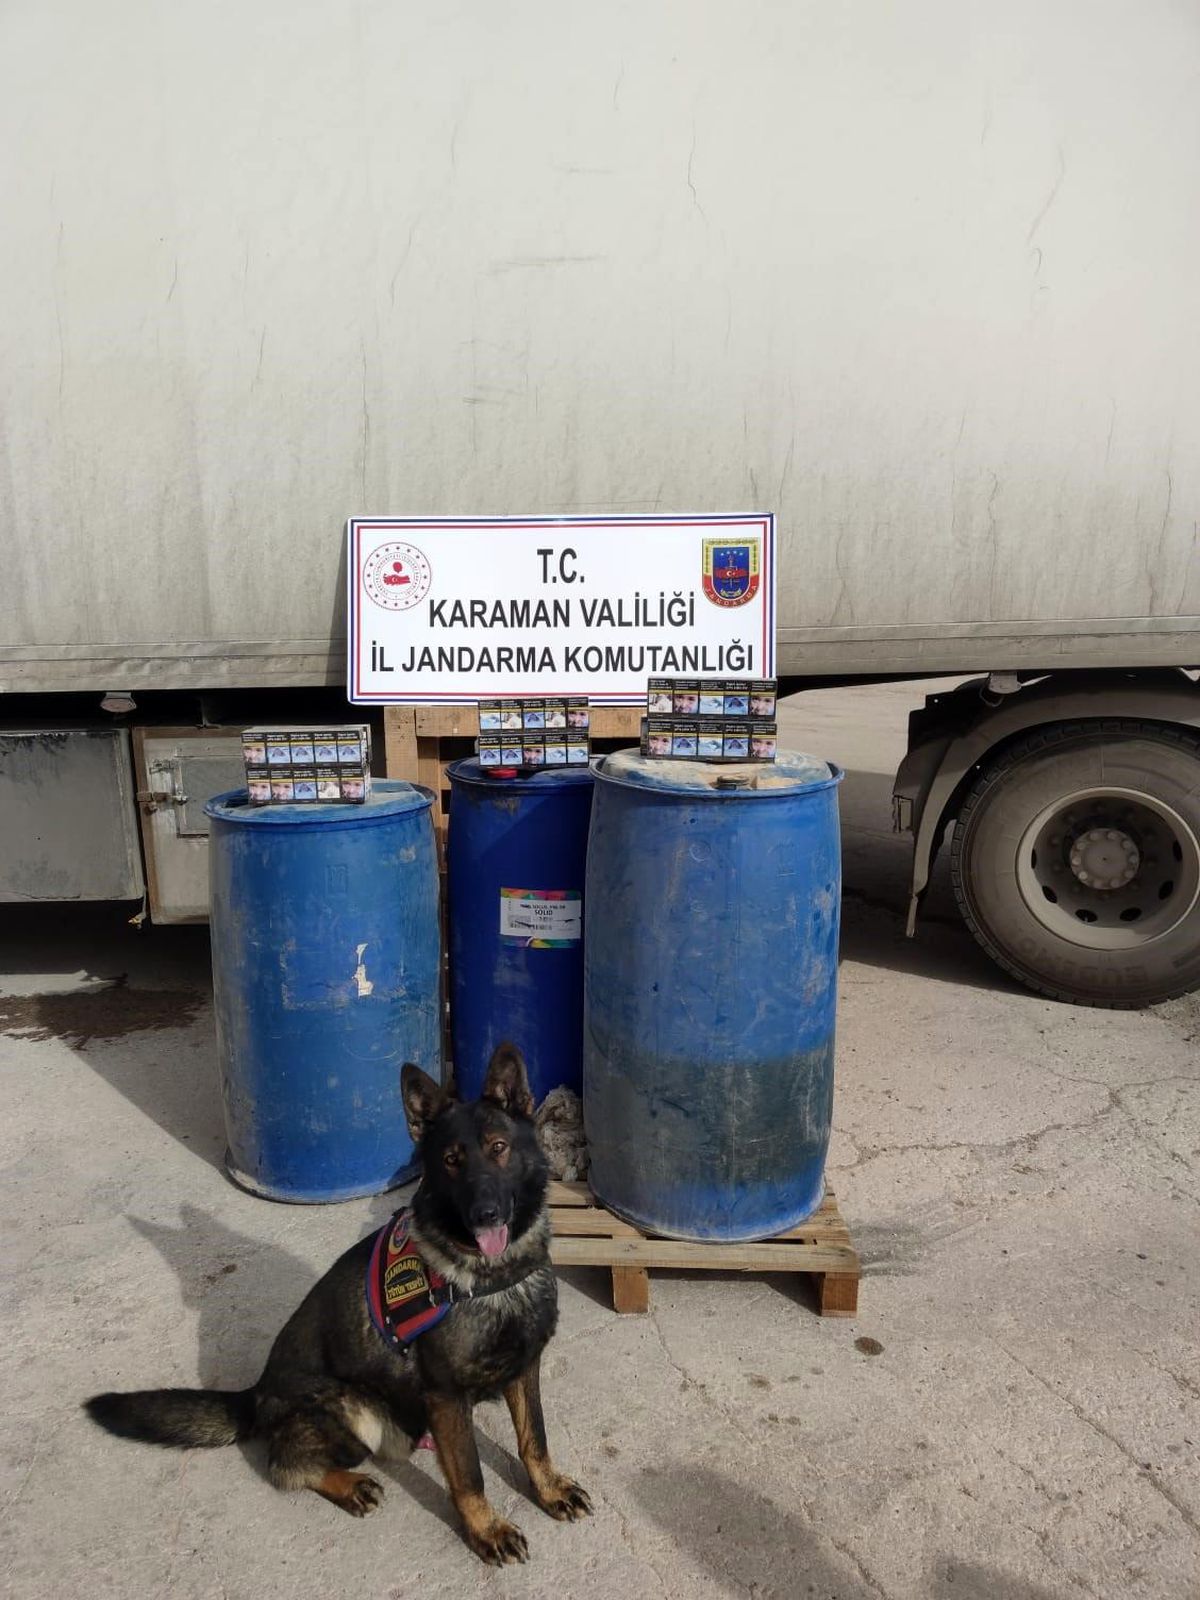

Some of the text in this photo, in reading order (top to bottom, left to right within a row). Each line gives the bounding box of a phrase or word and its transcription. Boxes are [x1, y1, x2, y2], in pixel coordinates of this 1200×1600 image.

[537, 548, 585, 584] T.C.
[429, 591, 695, 628] KARAMAN VALİLİĞİ
[371, 638, 753, 673] İL JANDARMA KOMUTANLIĞI
